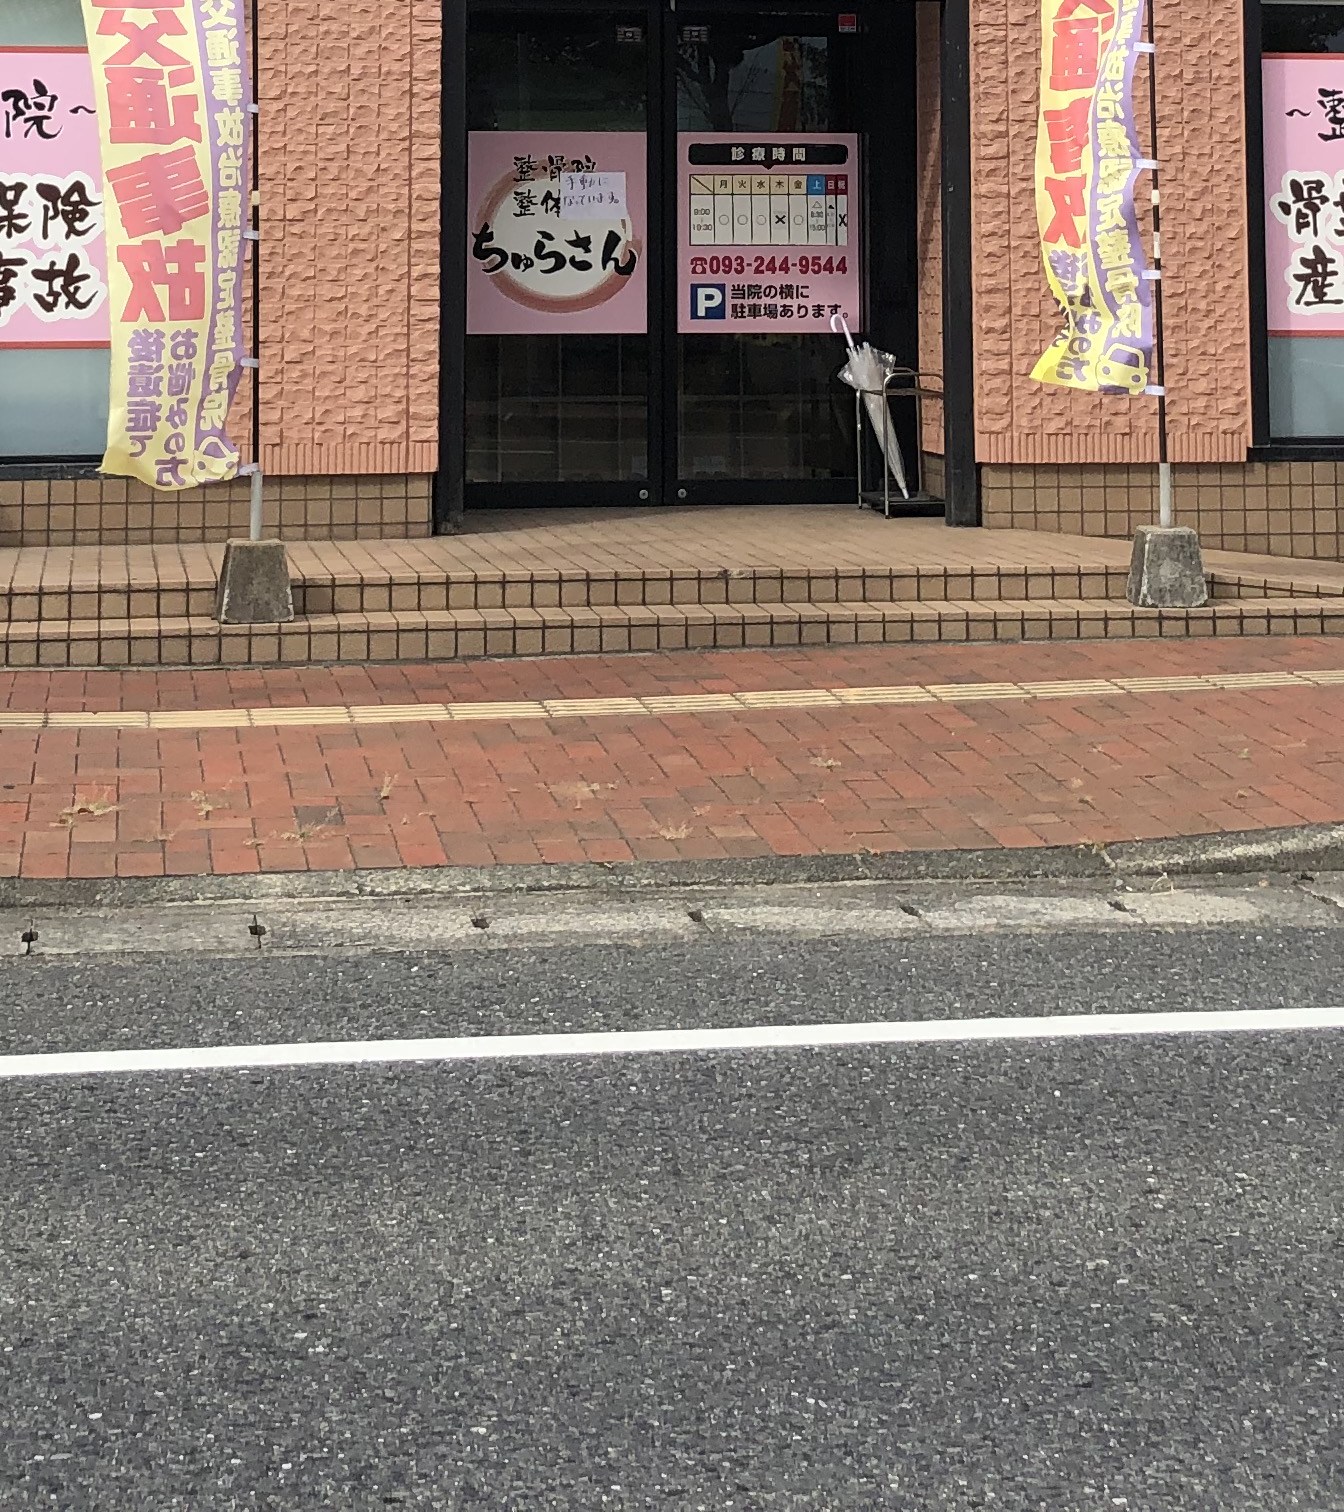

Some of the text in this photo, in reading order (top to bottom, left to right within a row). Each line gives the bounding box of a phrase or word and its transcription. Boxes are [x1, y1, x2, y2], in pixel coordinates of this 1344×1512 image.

[731, 147, 806, 161] 診療時間
[720, 180, 728, 188] 月
[738, 180, 747, 188] 火
[756, 180, 765, 189] 水
[775, 180, 784, 188] 木
[828, 181, 835, 189] 日
[472, 222, 636, 275] ちゅらさん
[709, 256, 847, 274] 093-244-9544
[731, 284, 810, 299] 当院の横に
[731, 304, 848, 319] 駐車場あります。
